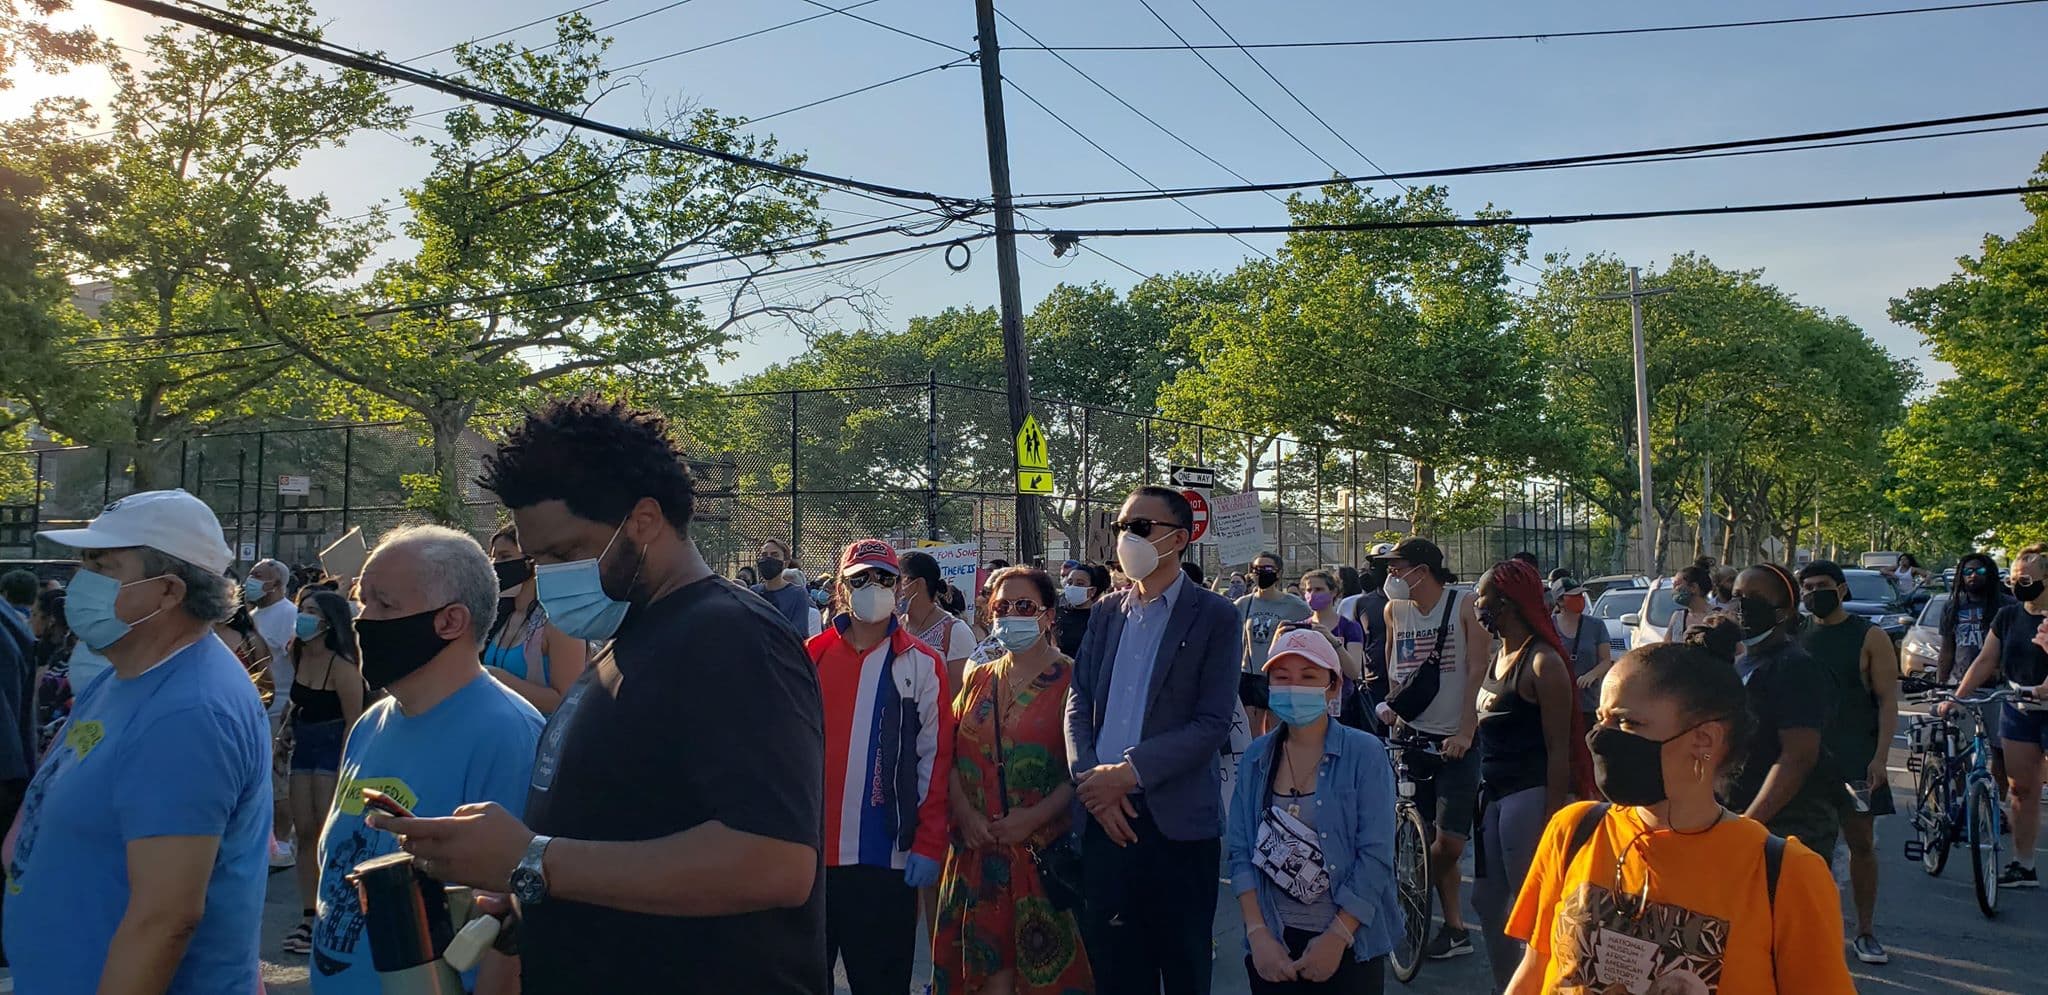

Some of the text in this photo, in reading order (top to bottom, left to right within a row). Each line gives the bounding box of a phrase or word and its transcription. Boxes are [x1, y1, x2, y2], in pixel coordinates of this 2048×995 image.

[1179, 472, 1210, 482] ONE WAY
[956, 548, 977, 558] SOME
[1607, 943, 1639, 956] MUSEUM
[1608, 936, 1646, 952] NATIONAL
[1605, 951, 1638, 965] AFRICAN
[1603, 965, 1635, 979] HISTORY
[1604, 958, 1644, 974] AMERICAN
